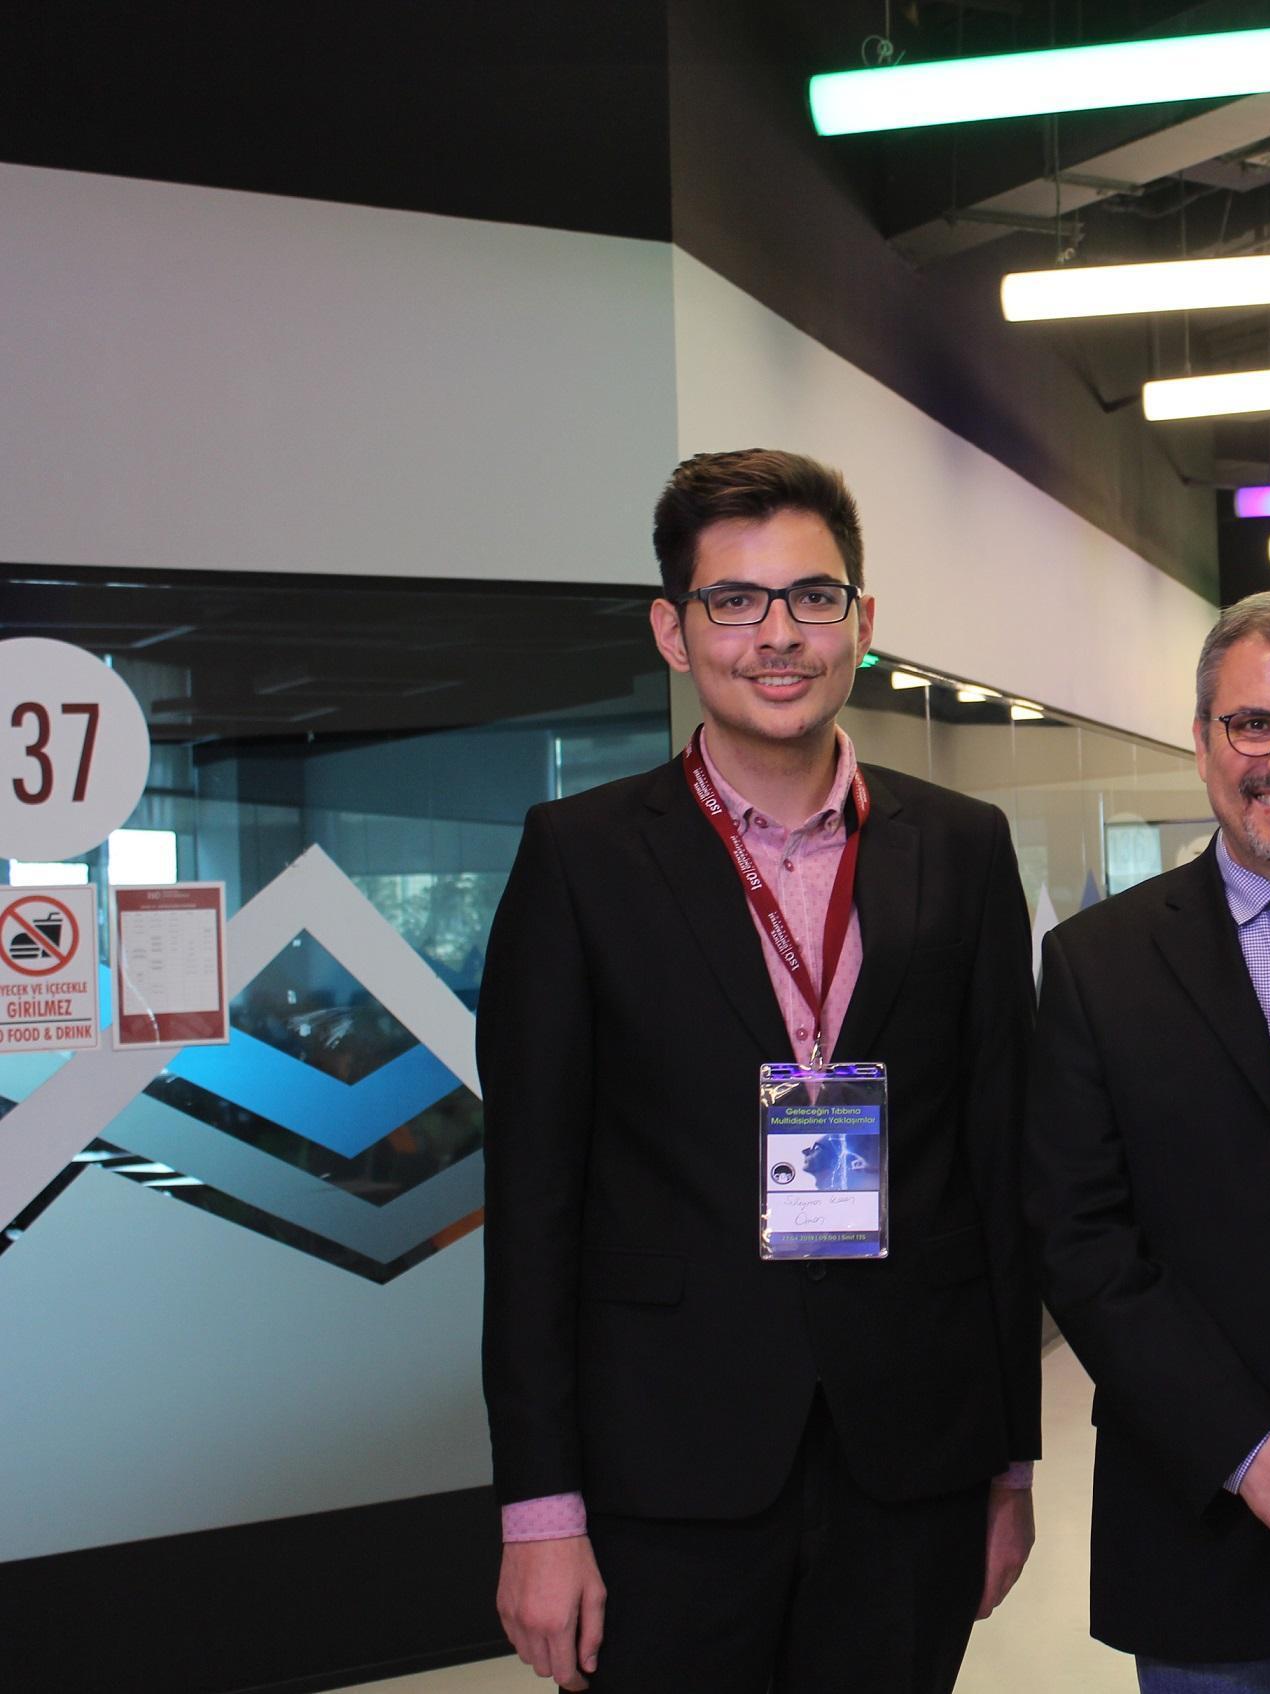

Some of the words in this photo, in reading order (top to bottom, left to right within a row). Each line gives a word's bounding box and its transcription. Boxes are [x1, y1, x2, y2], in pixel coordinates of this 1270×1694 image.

[11, 701, 100, 805] 37
[31, 984, 42, 995] VE
[46, 981, 87, 998] İÇECEKLE
[7, 997, 72, 1018] GİRİLMEZ
[8, 1028, 40, 1042] FOOD
[44, 1027, 52, 1040] &
[56, 1025, 92, 1040] DRINK
[786, 1108, 829, 1116] Geleceğin
